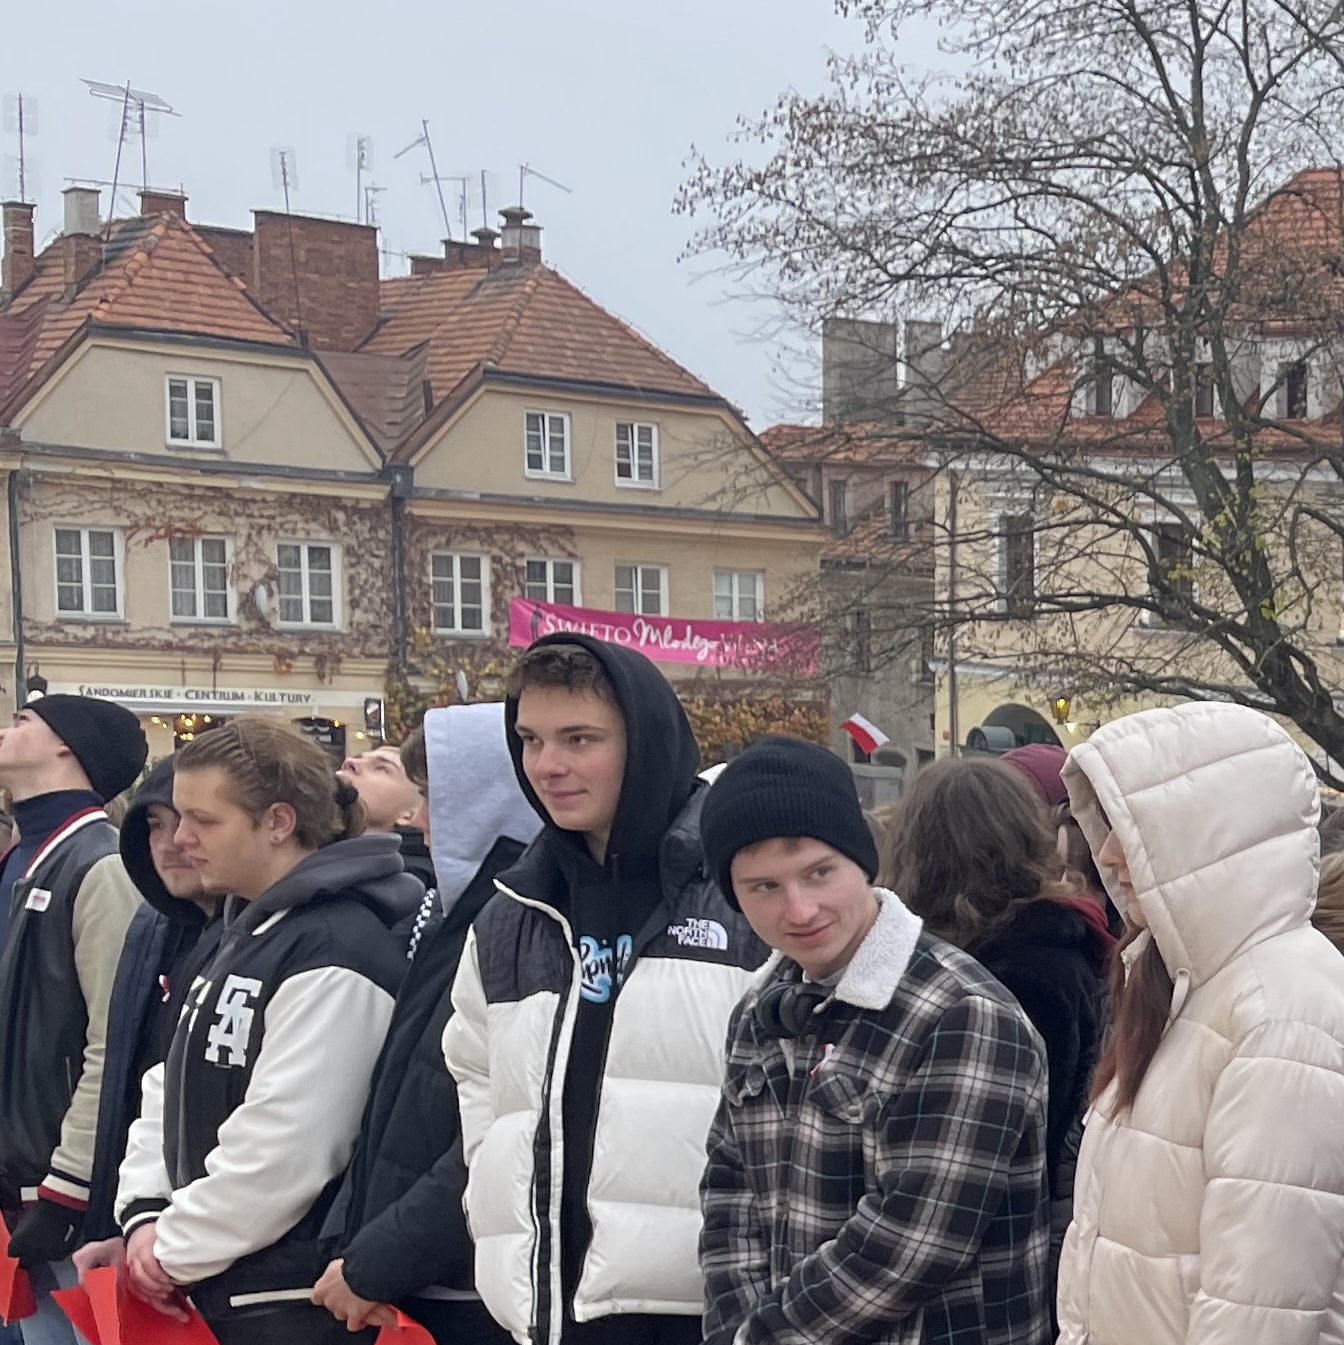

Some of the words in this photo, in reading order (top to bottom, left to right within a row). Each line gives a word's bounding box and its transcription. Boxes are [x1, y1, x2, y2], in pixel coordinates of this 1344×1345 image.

[78, 684, 173, 699] SANDOMIERSKIE
[184, 688, 245, 701] CENTRUM
[254, 690, 311, 703] KULTURY
[685, 917, 709, 929] THE
[667, 924, 709, 939] NORTH
[677, 935, 708, 947] FACE
